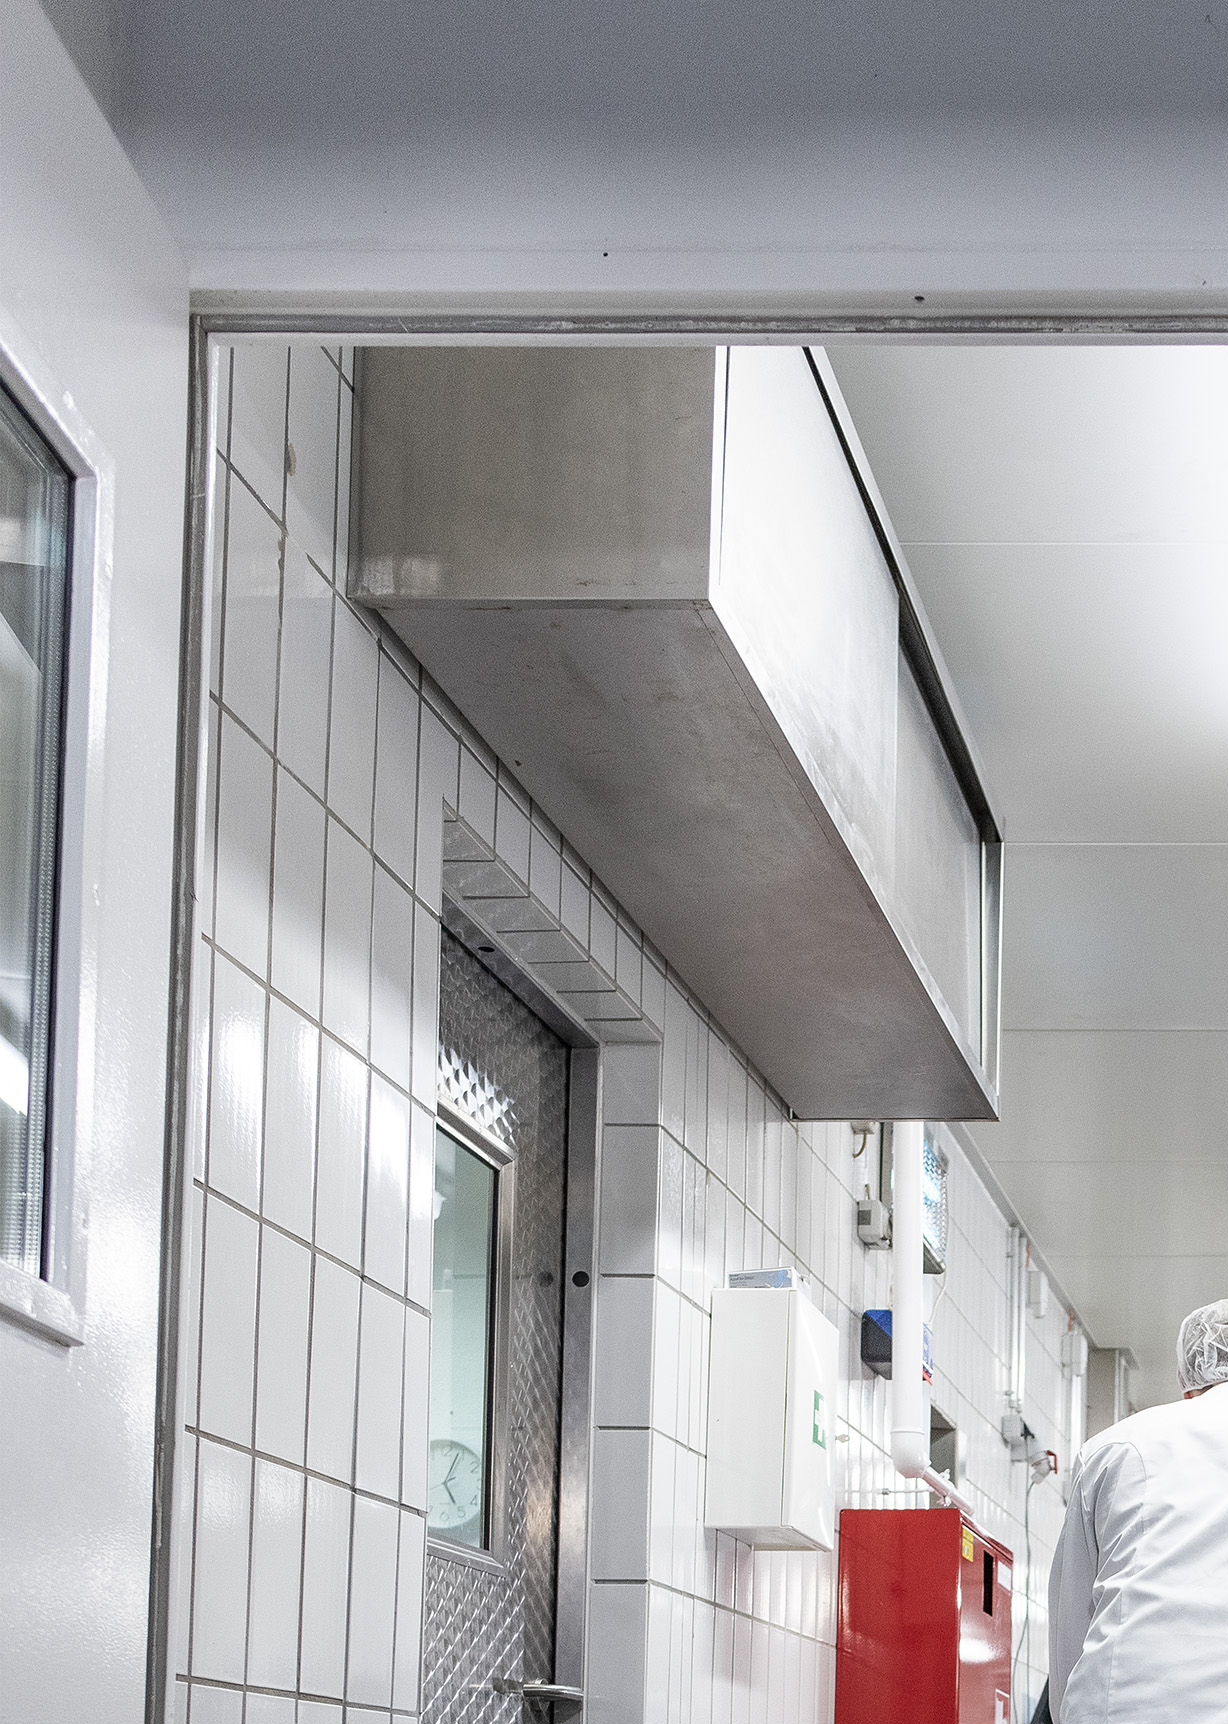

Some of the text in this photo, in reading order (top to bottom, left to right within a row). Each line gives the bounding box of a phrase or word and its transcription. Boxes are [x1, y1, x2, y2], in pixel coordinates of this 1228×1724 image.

[470, 1461, 480, 1474] 2
[469, 1494, 478, 1507] 4
[439, 1511, 450, 1522] 6
[457, 1505, 467, 1518] 5
